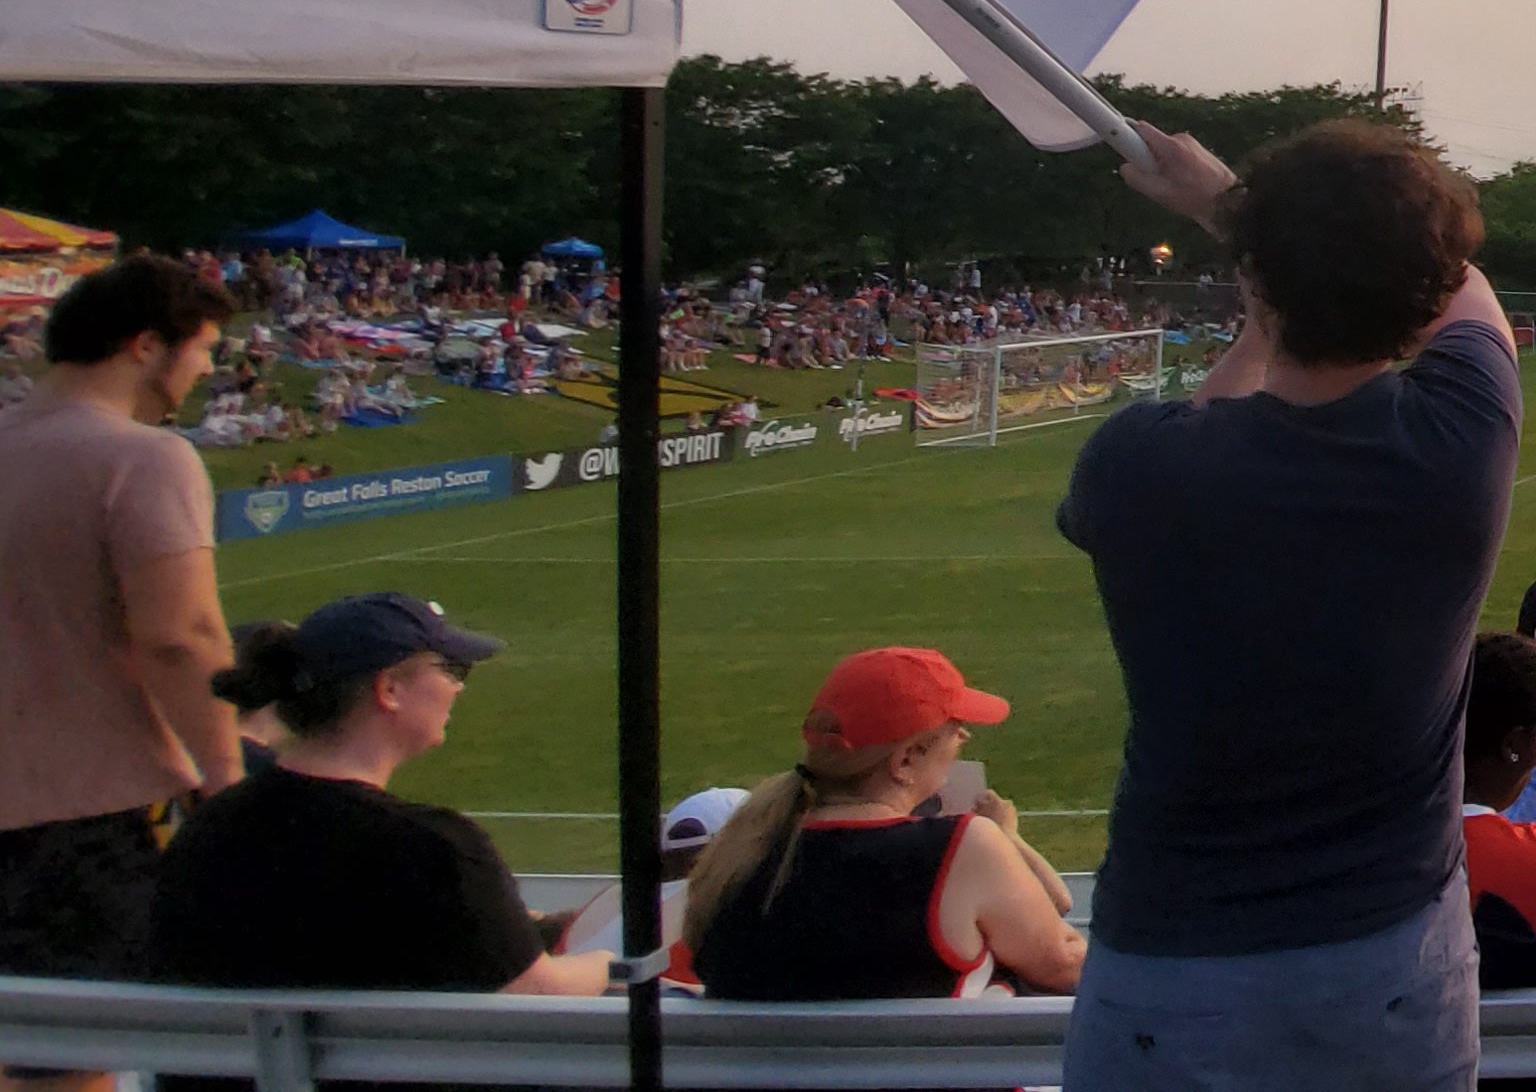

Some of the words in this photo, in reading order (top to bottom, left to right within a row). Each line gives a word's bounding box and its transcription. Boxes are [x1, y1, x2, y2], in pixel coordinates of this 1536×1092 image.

[579, 432, 726, 481] @WSPIRIT
[303, 487, 348, 508] Great
[351, 480, 388, 501] Falls
[391, 475, 442, 495] Reston
[444, 469, 491, 487] Soccer
